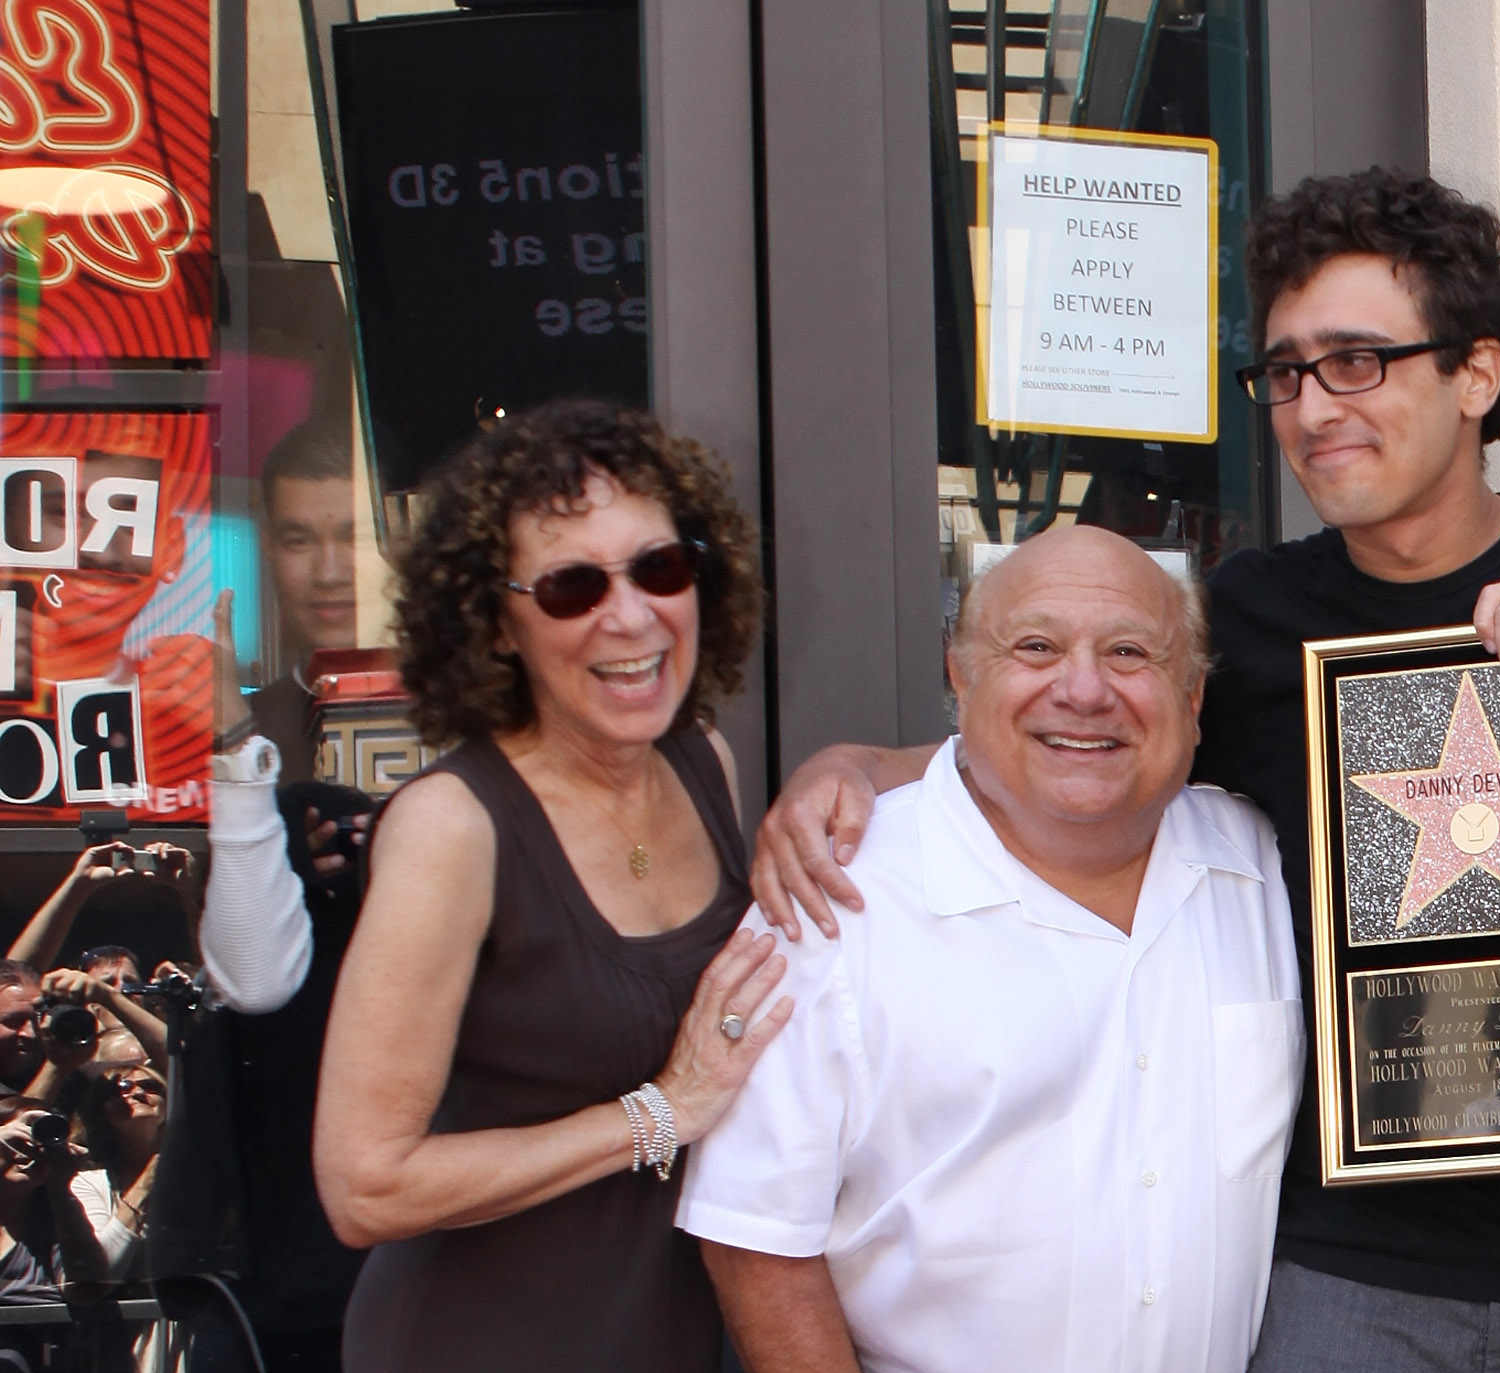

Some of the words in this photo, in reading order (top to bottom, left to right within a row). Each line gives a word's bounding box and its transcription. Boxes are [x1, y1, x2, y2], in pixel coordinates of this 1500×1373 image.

[1024, 174, 1077, 196] HELP
[1083, 178, 1181, 203] WANTED
[1067, 218, 1139, 240] PLEASE
[1071, 258, 1134, 280] APPLY
[1053, 293, 1152, 317] BETWEEN
[1040, 332, 1052, 350] 9
[1059, 334, 1093, 352] AM
[1114, 337, 1125, 354] 4
[1133, 338, 1165, 357] PM
[1088, 368, 1110, 376] STORE
[1405, 776, 1462, 800] DANNY
[1366, 973, 1463, 999] HOLLYWOOD
[1399, 1015, 1486, 1038] Danny
[1369, 1049, 1379, 1060] ON
[1384, 1048, 1397, 1059] THE
[1402, 1046, 1436, 1058] OCCASION
[1440, 1044, 1449, 1055] OF
[1455, 1042, 1467, 1053] THE
[1371, 1059, 1467, 1083] HOLLYWOOD
[1433, 1083, 1481, 1096] AUGUST
[1372, 1115, 1447, 1136] HOLLYWOOD
